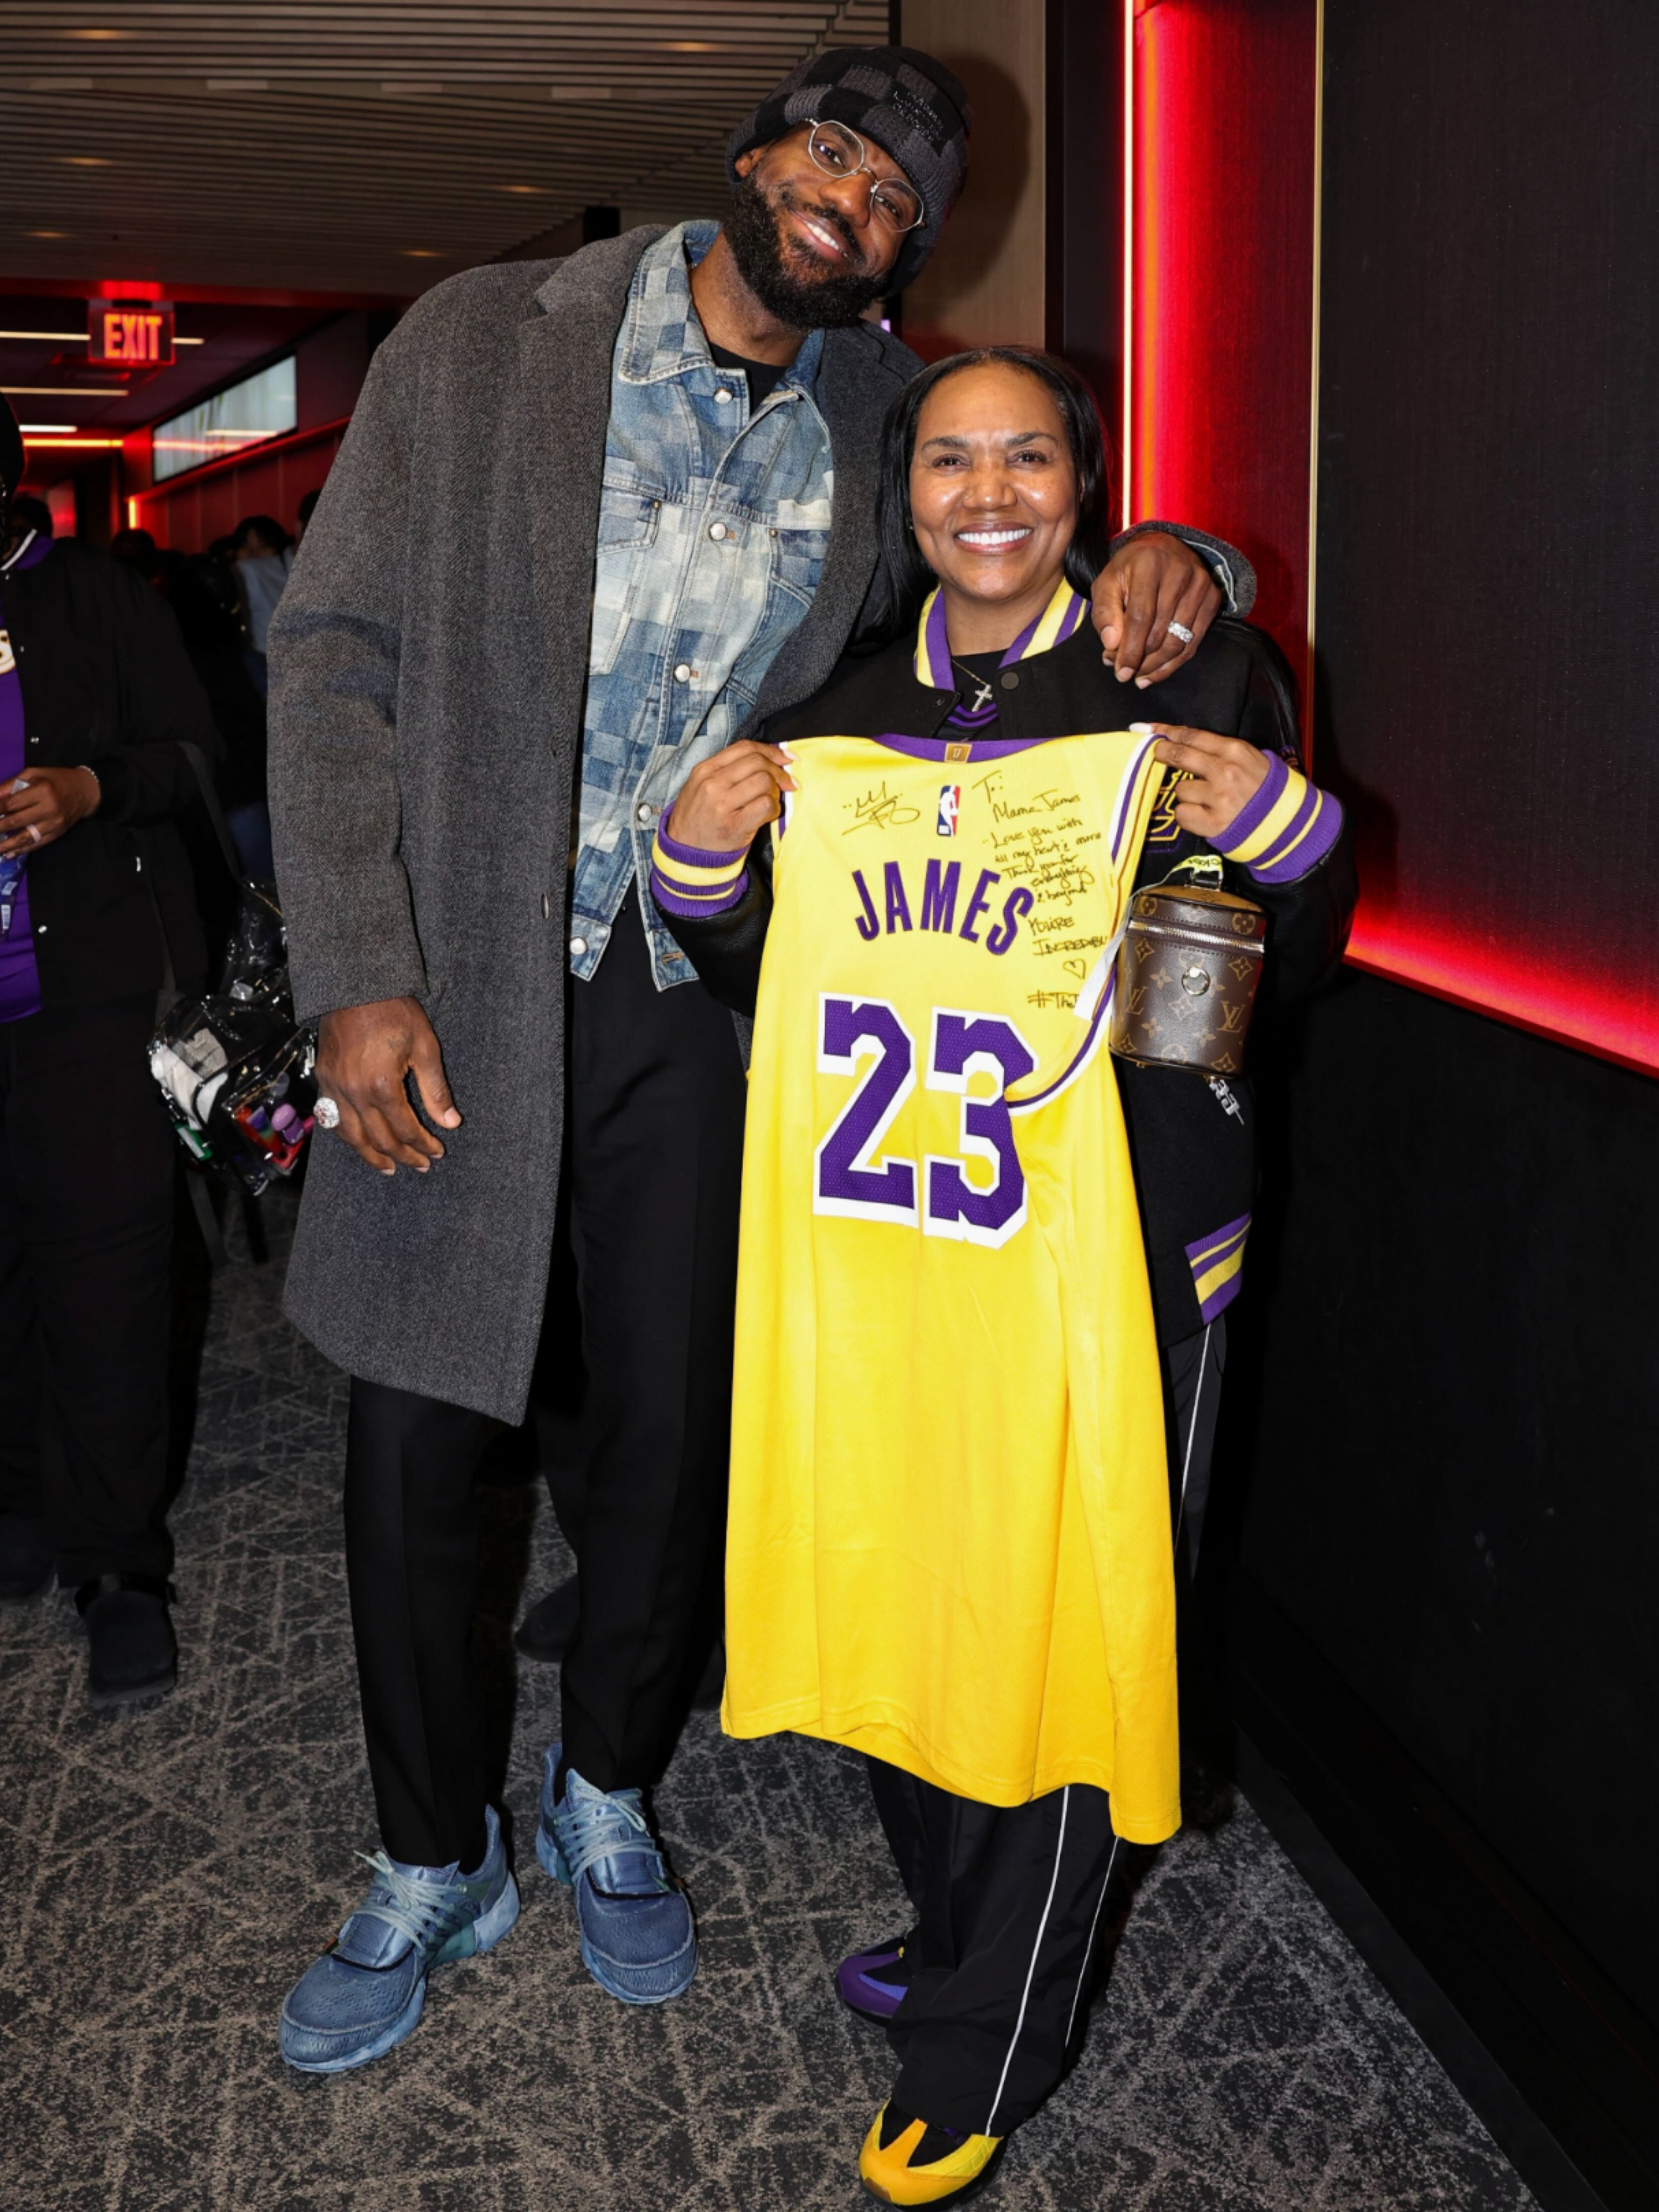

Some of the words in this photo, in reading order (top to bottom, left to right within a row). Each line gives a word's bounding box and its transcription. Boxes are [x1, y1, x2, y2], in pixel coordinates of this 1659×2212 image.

[103, 313, 163, 360] EXIT
[953, 747, 962, 758] 17
[993, 802, 1041, 822] Mama
[1033, 789, 1081, 812] James
[990, 832, 1025, 848] Love
[1028, 827, 1054, 845] you
[1057, 818, 1083, 831] with
[1013, 851, 1035, 871] my
[1033, 840, 1060, 856] heart
[1076, 832, 1101, 845] more
[1001, 865, 1039, 880] Thank
[1040, 862, 1060, 879] you
[1058, 854, 1079, 865] for
[1030, 865, 1095, 889] everything
[851, 858, 1034, 956] JAMES
[1046, 881, 1087, 906] beyond
[1033, 936, 1108, 956] INCREDIBL
[813, 992, 1040, 1250] 23
